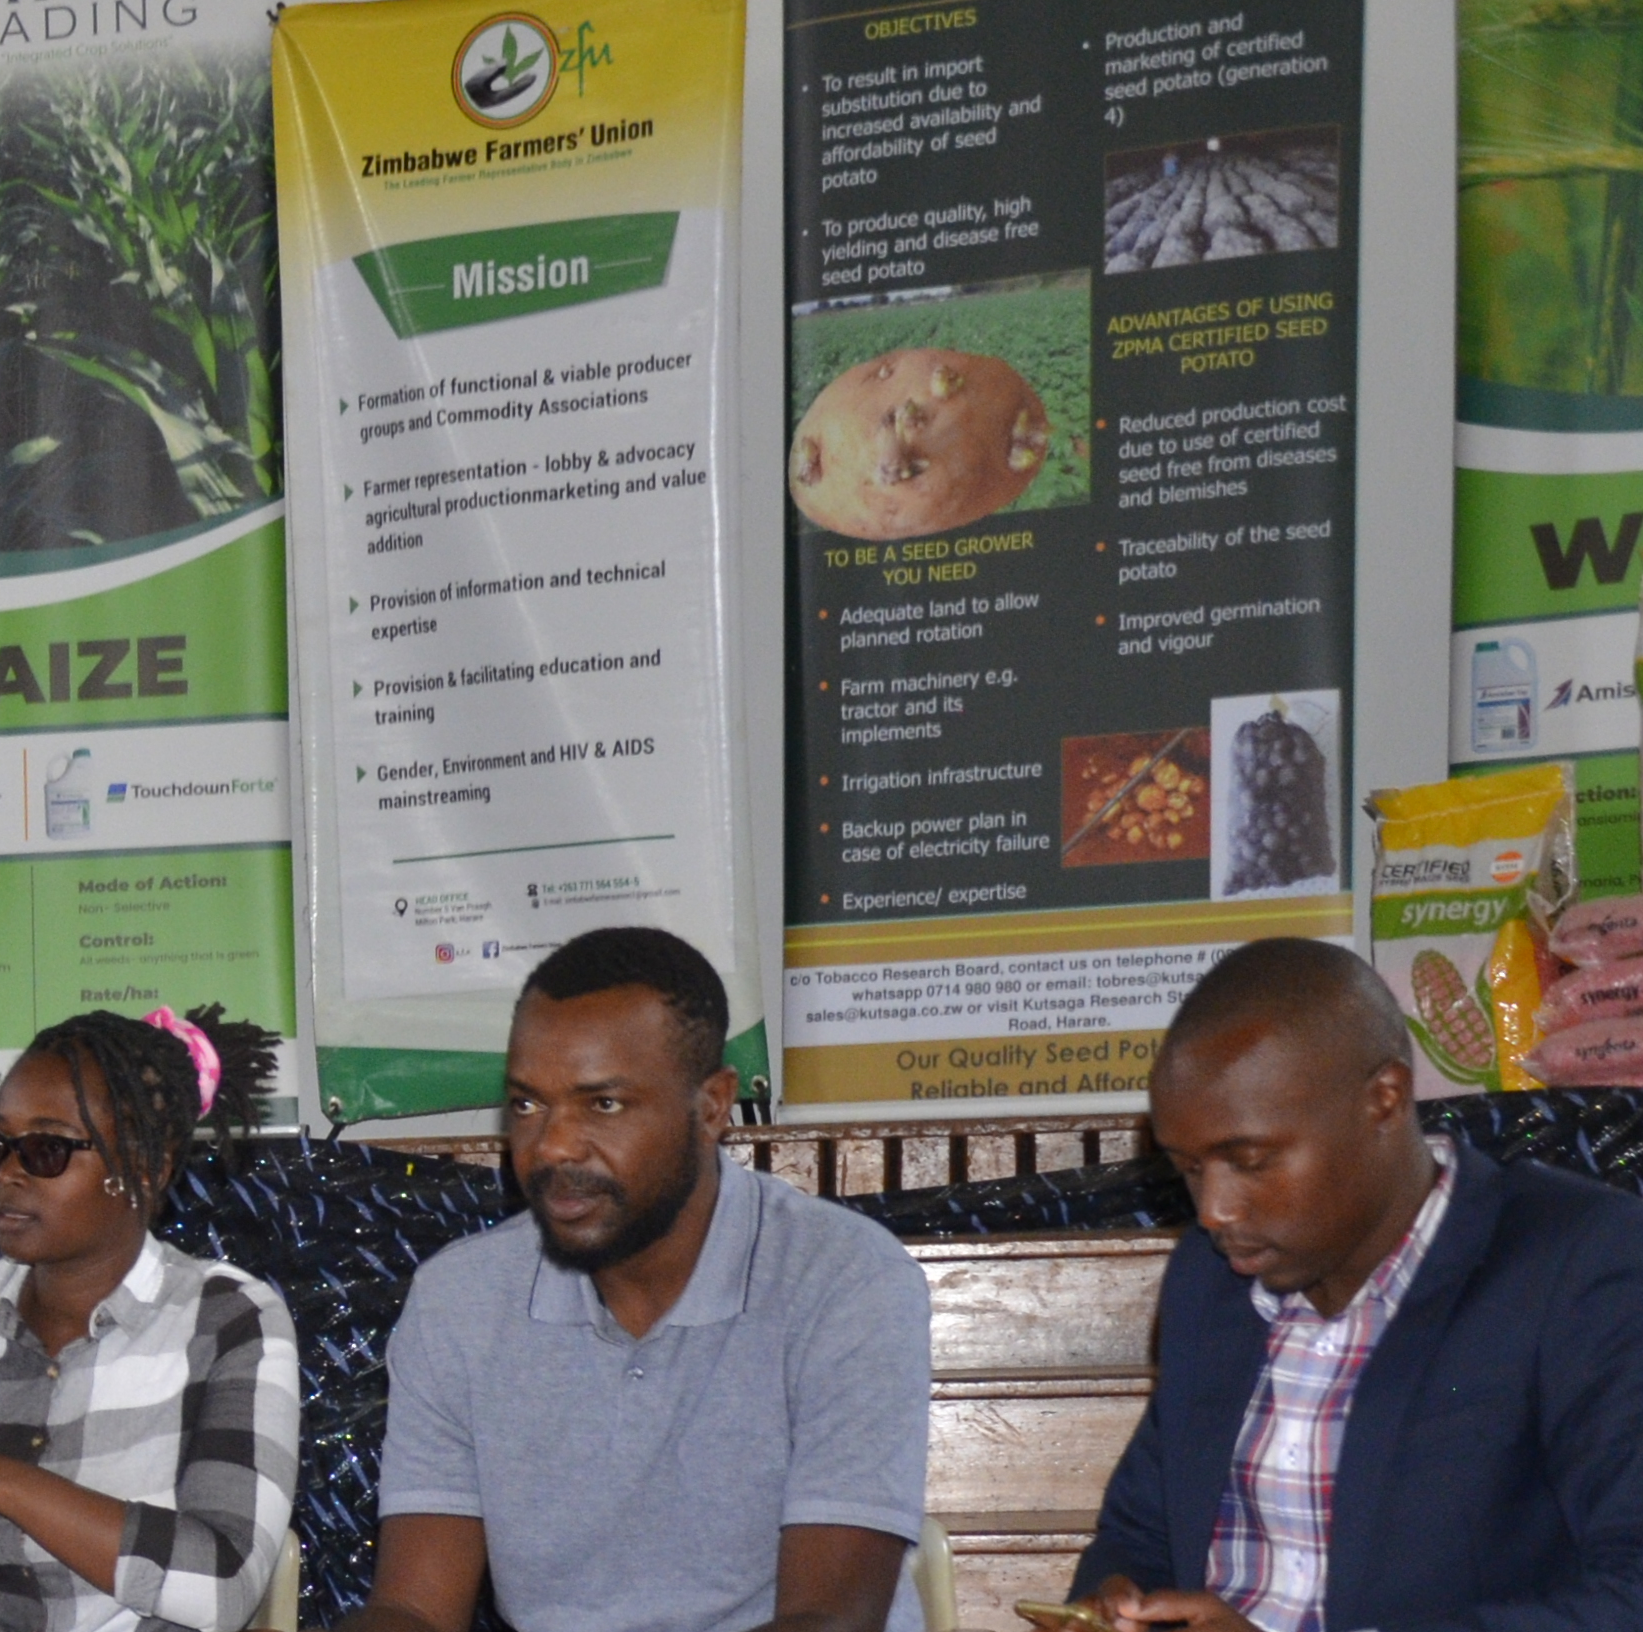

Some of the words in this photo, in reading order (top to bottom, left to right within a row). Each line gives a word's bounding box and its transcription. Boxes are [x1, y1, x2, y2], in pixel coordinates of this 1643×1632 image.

[865, 8, 978, 40] OBJECTIVES
[822, 74, 842, 92] To
[848, 67, 896, 88] result
[903, 64, 917, 80] in
[925, 55, 983, 80] import
[822, 89, 922, 117] substitution
[929, 84, 962, 103] due
[969, 81, 987, 97] to
[822, 114, 904, 141] increased
[910, 103, 1002, 130] availability
[1009, 94, 1041, 117] and
[362, 148, 477, 178] Zimbabwe
[486, 127, 585, 162] Farmers'
[591, 120, 653, 146] Union
[822, 136, 923, 166] affordability
[931, 131, 949, 151] of
[955, 127, 997, 148] seed
[822, 168, 877, 192] potato
[453, 254, 588, 300] Mission
[1108, 302, 1230, 334] ADVANTAGES
[1236, 298, 1263, 317] OF
[1270, 291, 1334, 314] USING
[1112, 336, 1163, 359] ZPMA
[1169, 323, 1269, 351] CERTIFIED
[1276, 318, 1328, 339] SEED
[1181, 350, 1255, 374] POTATO
[359, 385, 425, 411] Formation
[429, 379, 446, 398] of
[451, 370, 537, 395] functional
[544, 369, 554, 385] &
[561, 362, 611, 383] viable
[617, 353, 691, 381] producer
[360, 417, 405, 444] groups
[409, 412, 432, 430] and
[437, 400, 533, 426] Commodity
[539, 389, 648, 416] Associations
[364, 478, 410, 498] Farmer
[415, 456, 527, 492] representation
[546, 453, 592, 473] lobby
[598, 450, 609, 467] &
[616, 442, 695, 465] advocacy
[366, 498, 441, 528] agricultural
[625, 472, 656, 493] and
[662, 468, 706, 489] value
[368, 532, 423, 555] addition
[825, 550, 848, 567] TO
[855, 547, 877, 565] BE
[884, 545, 896, 562] A
[902, 540, 948, 561] SEED
[955, 531, 1034, 556] GROWER
[371, 588, 436, 611] Provision
[441, 582, 453, 600] of
[456, 573, 544, 599] information
[550, 568, 581, 589] and
[587, 560, 665, 584] technical
[884, 567, 920, 585] YOU
[929, 562, 977, 583] NEED
[371, 618, 437, 642] expertise
[374, 674, 444, 696] Provision
[447, 671, 457, 688] &
[461, 662, 535, 686] facilitating
[539, 653, 624, 676] education
[630, 649, 661, 668] and
[1577, 680, 1636, 703] Amis
[375, 704, 435, 725] training
[378, 761, 439, 782] Gender,
[443, 751, 526, 776] Environment
[530, 746, 555, 765] and
[560, 743, 588, 761] HIV
[595, 742, 606, 758] &
[613, 737, 654, 757] AIDS
[379, 784, 491, 810] mainstreaming
[1401, 898, 1507, 927] synergy
[790, 975, 810, 986] c/o
[816, 971, 878, 985] Tobacco
[883, 964, 949, 980] Research
[806, 1005, 962, 1023] sales@kutsaga.co.zw
[896, 1050, 939, 1070] Our
[946, 1045, 1036, 1069] Quality
[1047, 1041, 1108, 1063] Seed
[1119, 1039, 1160, 1059] Pot
[910, 1078, 1008, 1100] Reliable
[1019, 1074, 1066, 1095] and
